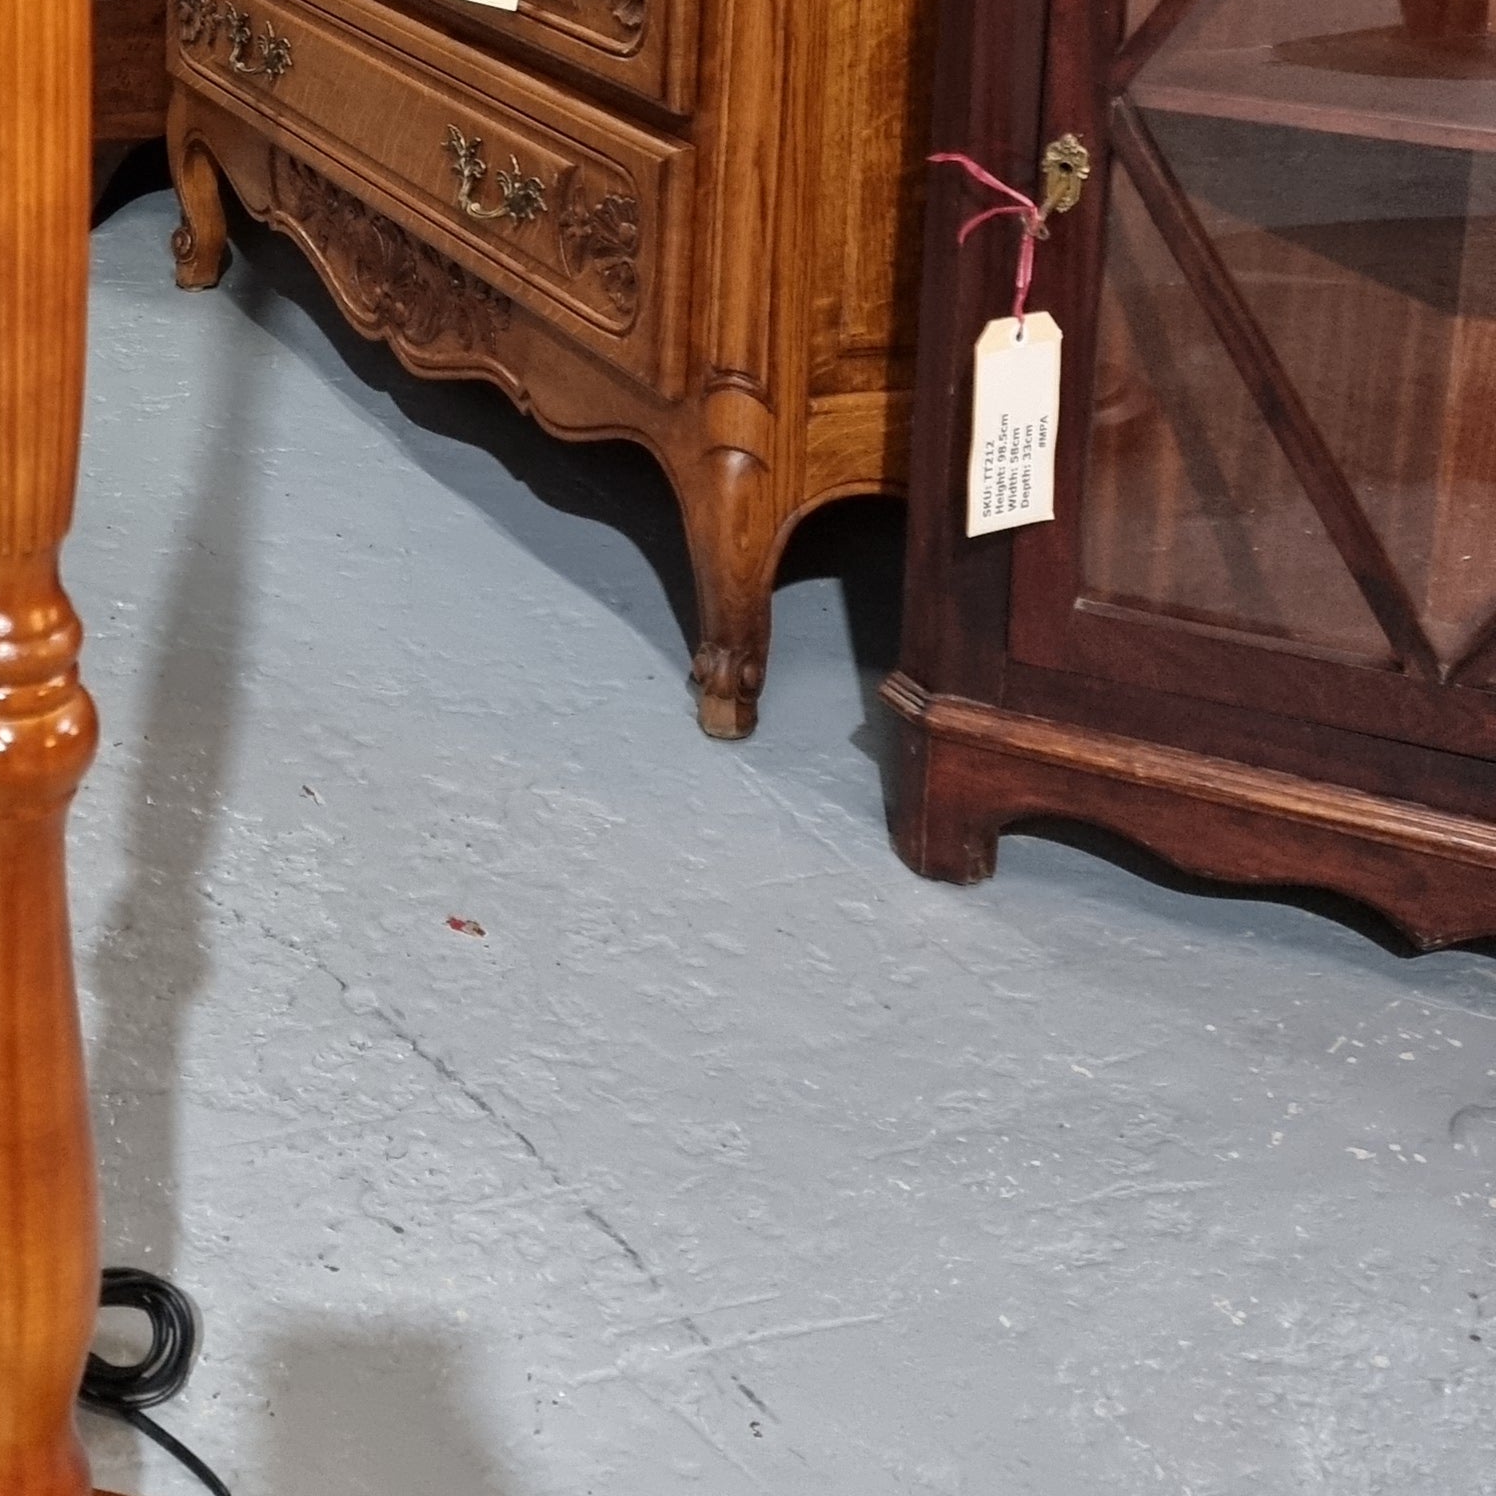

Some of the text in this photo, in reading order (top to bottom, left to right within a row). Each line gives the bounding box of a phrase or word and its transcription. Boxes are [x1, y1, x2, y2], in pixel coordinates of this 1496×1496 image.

[982, 440, 995, 518] SKU: TT212
[995, 413, 1009, 515] Height: 98.5cm
[1008, 427, 1020, 512] Width: 58cm
[1020, 424, 1033, 509] Depth: 33cm
